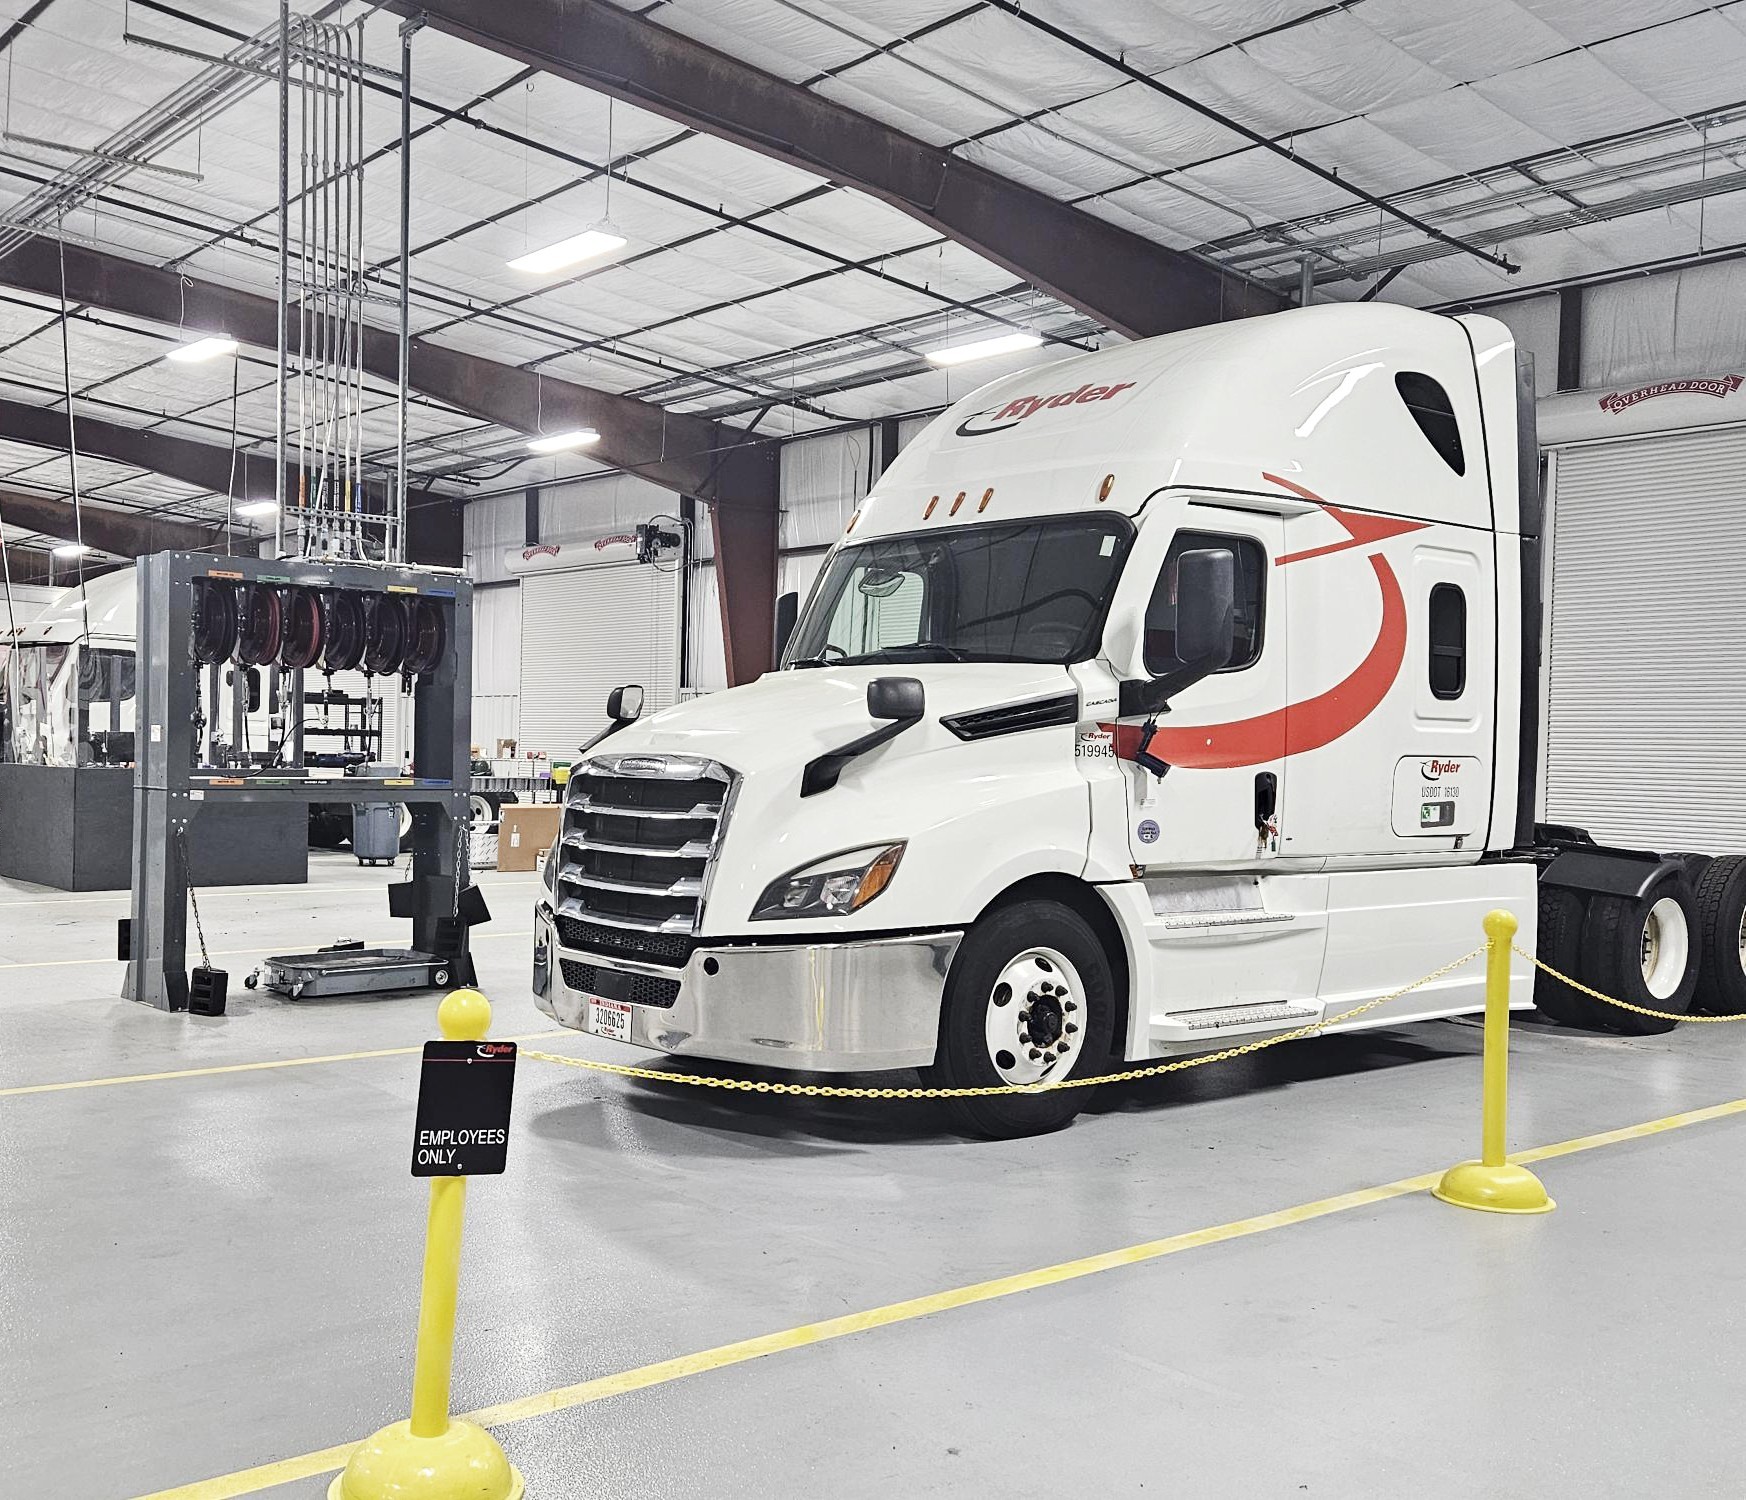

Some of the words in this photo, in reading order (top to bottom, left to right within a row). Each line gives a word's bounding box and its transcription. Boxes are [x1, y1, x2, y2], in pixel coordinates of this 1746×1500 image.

[991, 382, 1137, 421] Ryder
[1613, 382, 1686, 410] OVERHEAD
[1690, 381, 1726, 394] DOOR
[1088, 732, 1110, 740] Ryder
[1075, 744, 1115, 758] 519945
[1431, 760, 1460, 776] Ryder
[1421, 786, 1441, 797] USDOT
[596, 1007, 625, 1029] 3206625
[485, 1044, 513, 1054] Ryder
[420, 1129, 505, 1145] EMPLOYEES
[418, 1149, 456, 1164] ONLY
